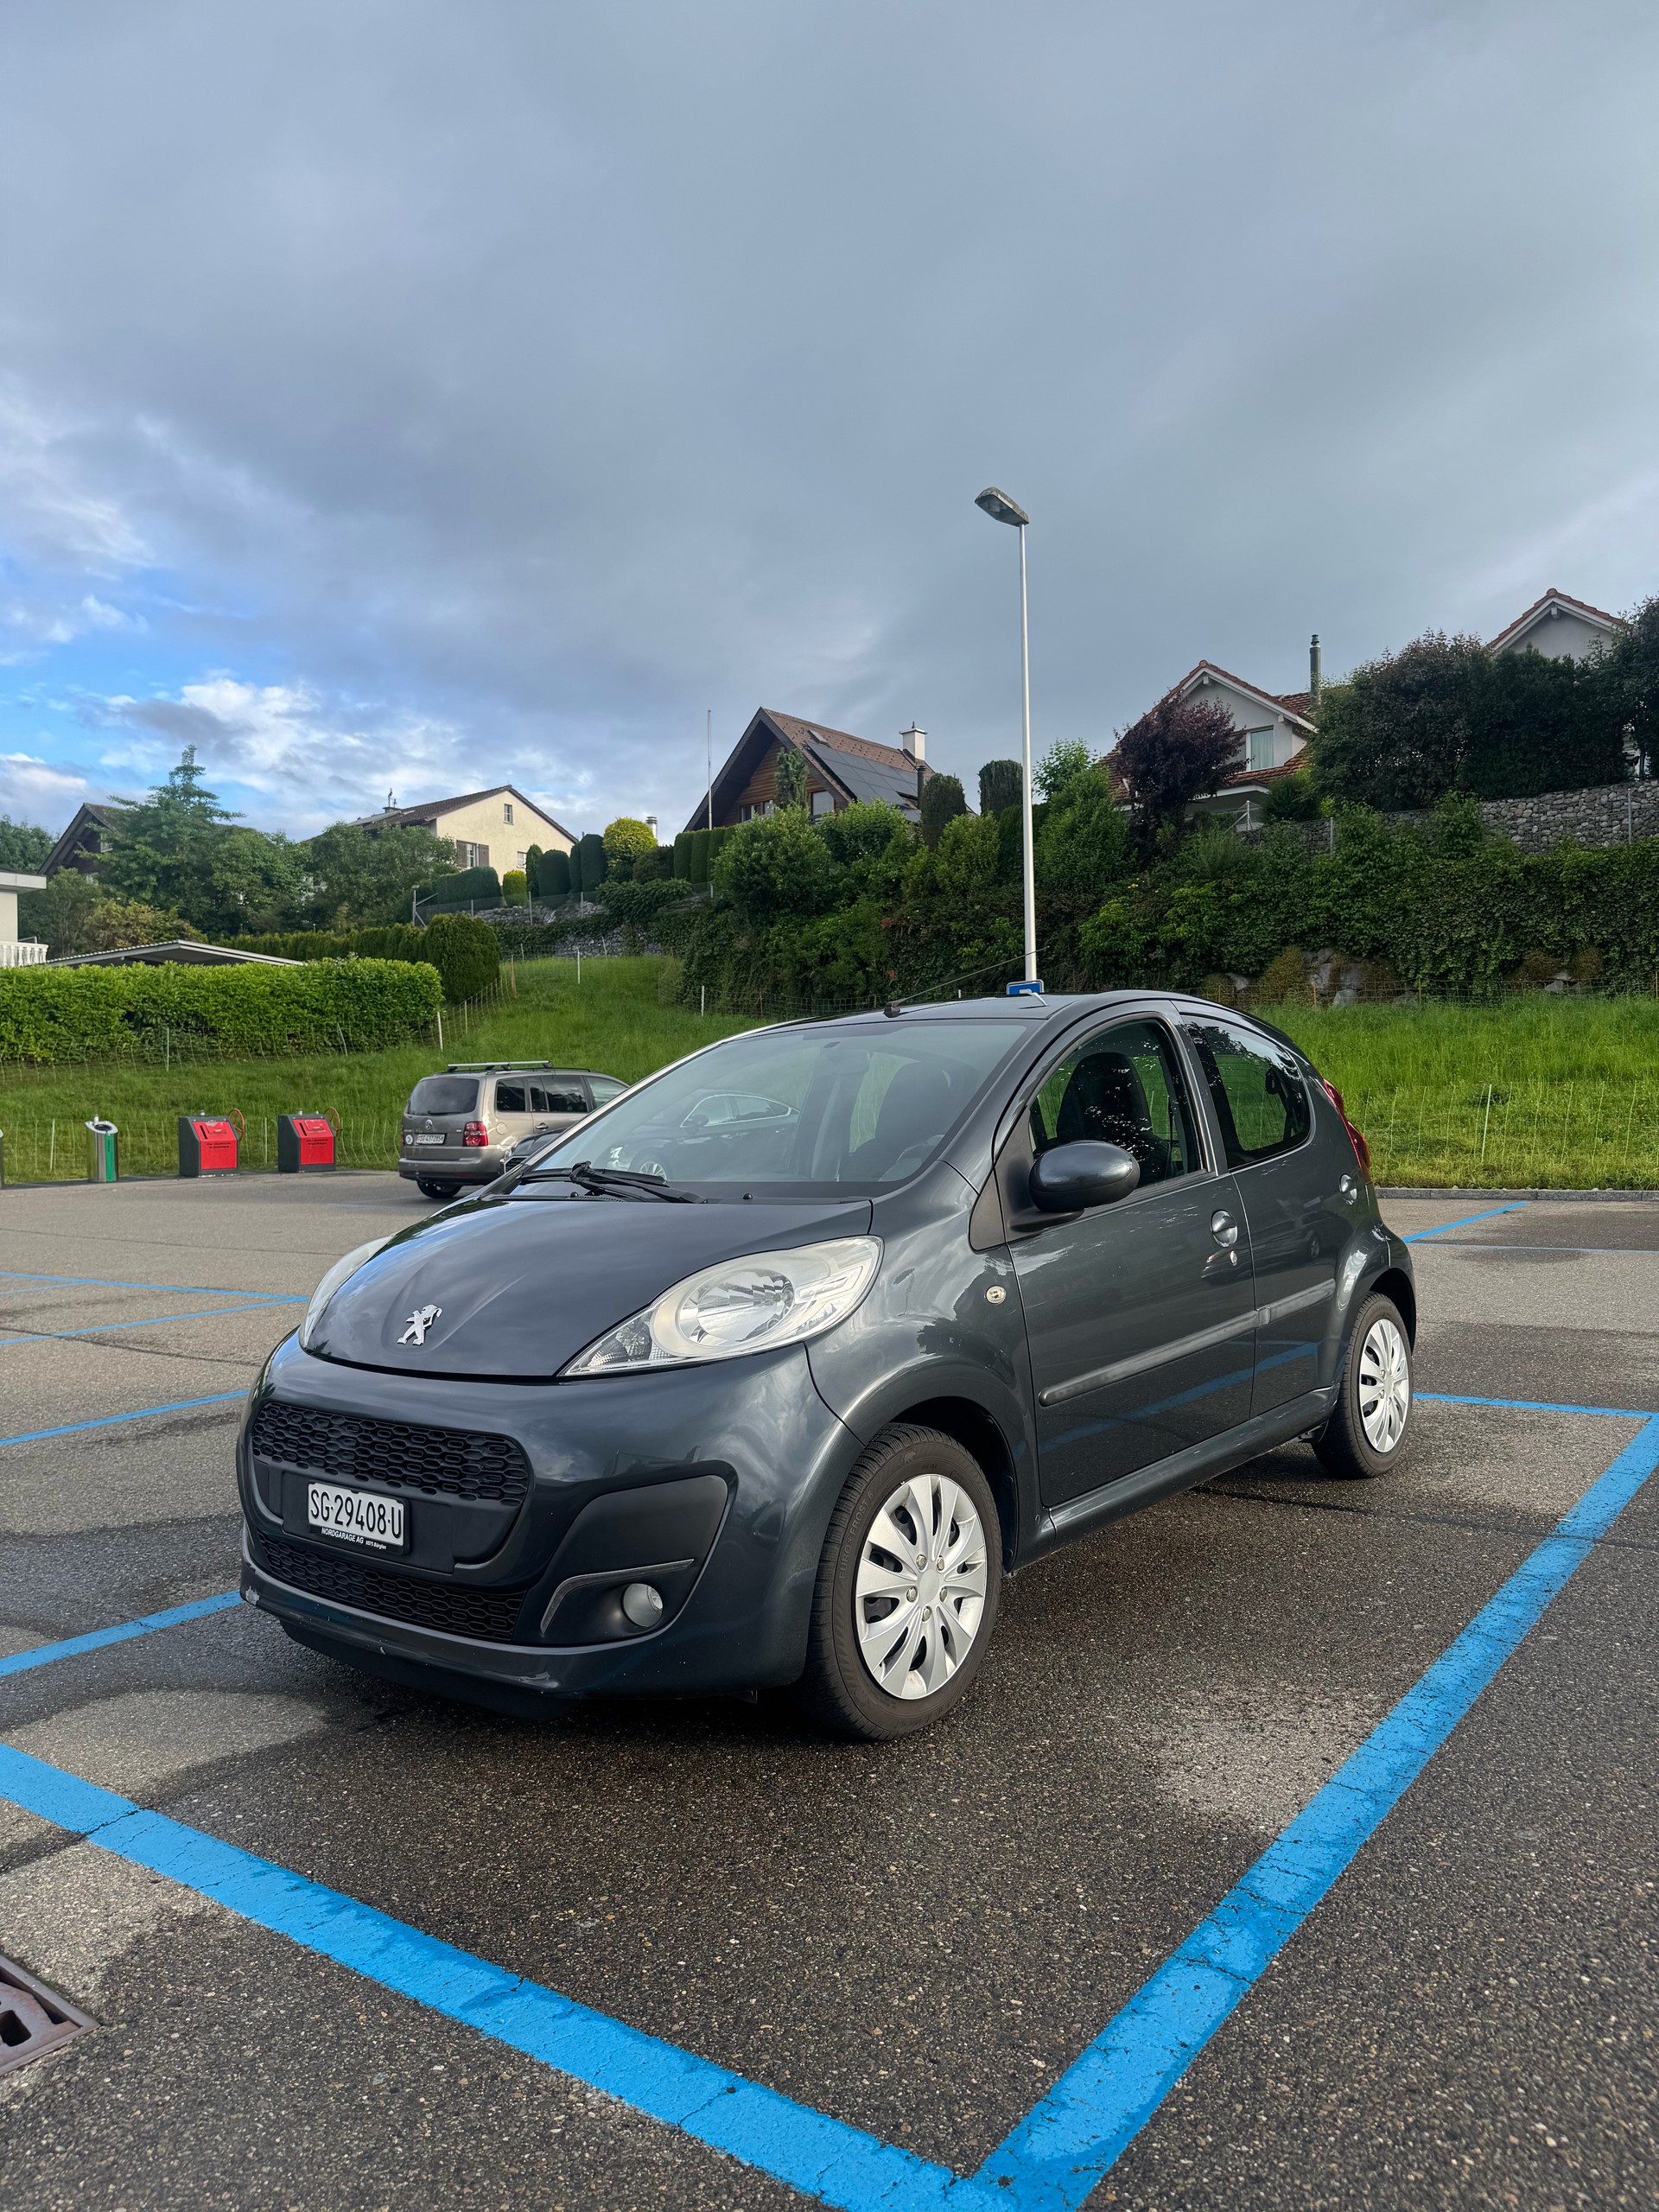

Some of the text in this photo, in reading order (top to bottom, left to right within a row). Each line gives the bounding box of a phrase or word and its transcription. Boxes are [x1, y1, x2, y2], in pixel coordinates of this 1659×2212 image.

[849, 1500, 869, 1535] FROST
[321, 1527, 355, 1542] NORDGARAGE
[355, 1535, 365, 1544] AG
